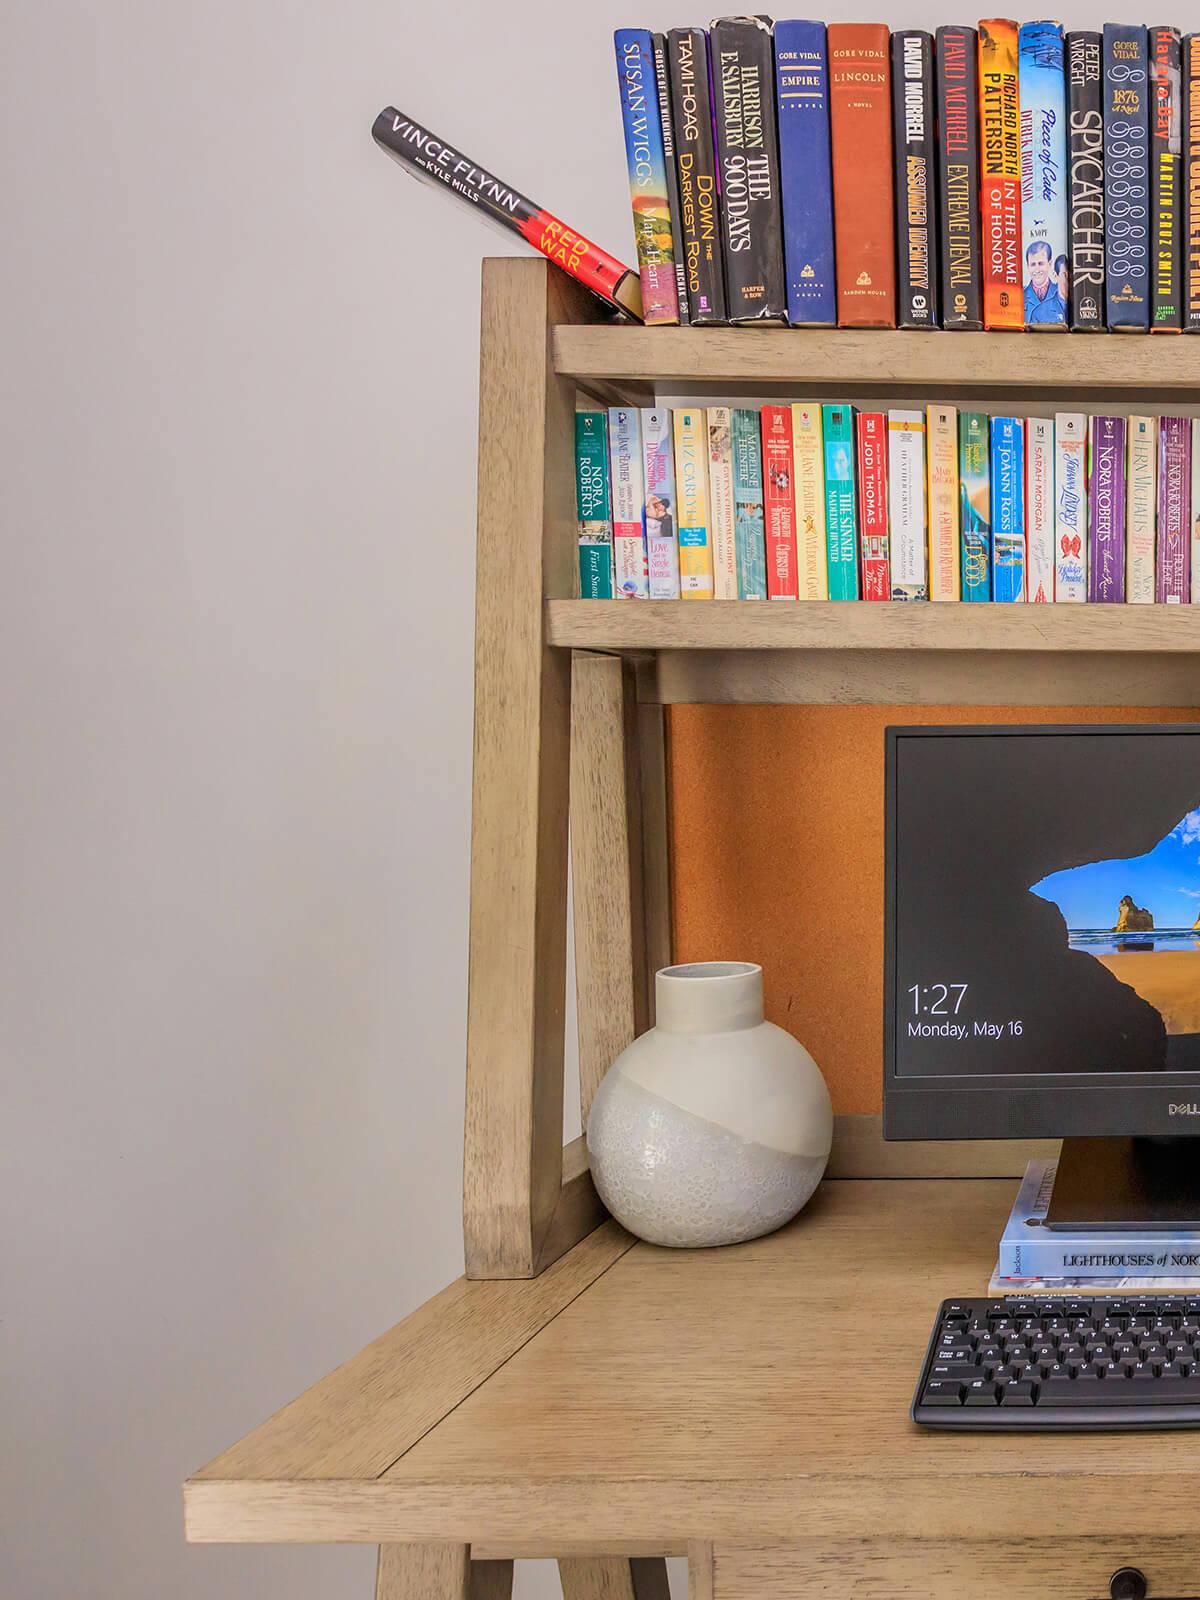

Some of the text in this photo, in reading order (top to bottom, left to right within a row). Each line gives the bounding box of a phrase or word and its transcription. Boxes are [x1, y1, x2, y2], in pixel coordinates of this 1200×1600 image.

[779, 52, 821, 60] GORE VIDAL
[1070, 39, 1085, 87] WRIGHT
[1086, 44, 1099, 81] PETER
[1113, 41, 1139, 50] GORE
[1113, 50, 1140, 59] VIDAL
[679, 34, 698, 141] TAMI HOAG
[782, 76, 820, 86] EMPIRE
[834, 73, 885, 82] LINCOLN
[904, 37, 924, 144] DAVID MORRELL
[943, 35, 968, 156] DAVID MORRELL
[1112, 90, 1140, 104] 1876
[624, 43, 652, 188] SUSAN WIGGS
[722, 66, 744, 149] SALISBURY
[741, 66, 764, 149] HARRISON
[984, 73, 1003, 174] PATTERSON
[1003, 74, 1018, 175] RICHARD NORTH
[391, 115, 520, 211] VINCE FLYNN
[426, 161, 479, 202] KYLE MILLS
[747, 154, 771, 200] THE
[680, 154, 700, 292] DARKEST ROAD
[697, 176, 714, 240] DOWN
[724, 155, 751, 252] 900 DAYS
[907, 156, 928, 289] ASSUMED IDENTITY
[948, 165, 970, 232] EXTREME
[1070, 110, 1104, 288] SPYCATCHER
[1158, 153, 1173, 295] MARTIN CRUZ SMITH
[540, 233, 580, 272] WAR
[545, 221, 589, 256] RED
[640, 208, 661, 288] Map Heart
[990, 189, 1003, 275] OF HONOR
[1004, 182, 1017, 284] IN THE NAME
[949, 236, 971, 288] DENIAL
[580, 457, 593, 516] ROBERTS
[592, 466, 603, 507] NORA
[739, 439, 748, 481] HUNTER
[747, 434, 758, 488] MADELINE
[864, 442, 876, 525] JODI THOMAS
[1001, 497, 1011, 530] ROSS
[1097, 446, 1113, 541] NORA ROBERTS
[840, 492, 853, 562] THE SINNER
[589, 550, 600, 574] First
[908, 984, 968, 1015] 1:27
[908, 1021, 1023, 1040] Monday, May 16
[1168, 1104, 1200, 1115] DELL
[1063, 1255, 1154, 1266] LIGHTHOUSES
[1157, 1254, 1167, 1266] of
